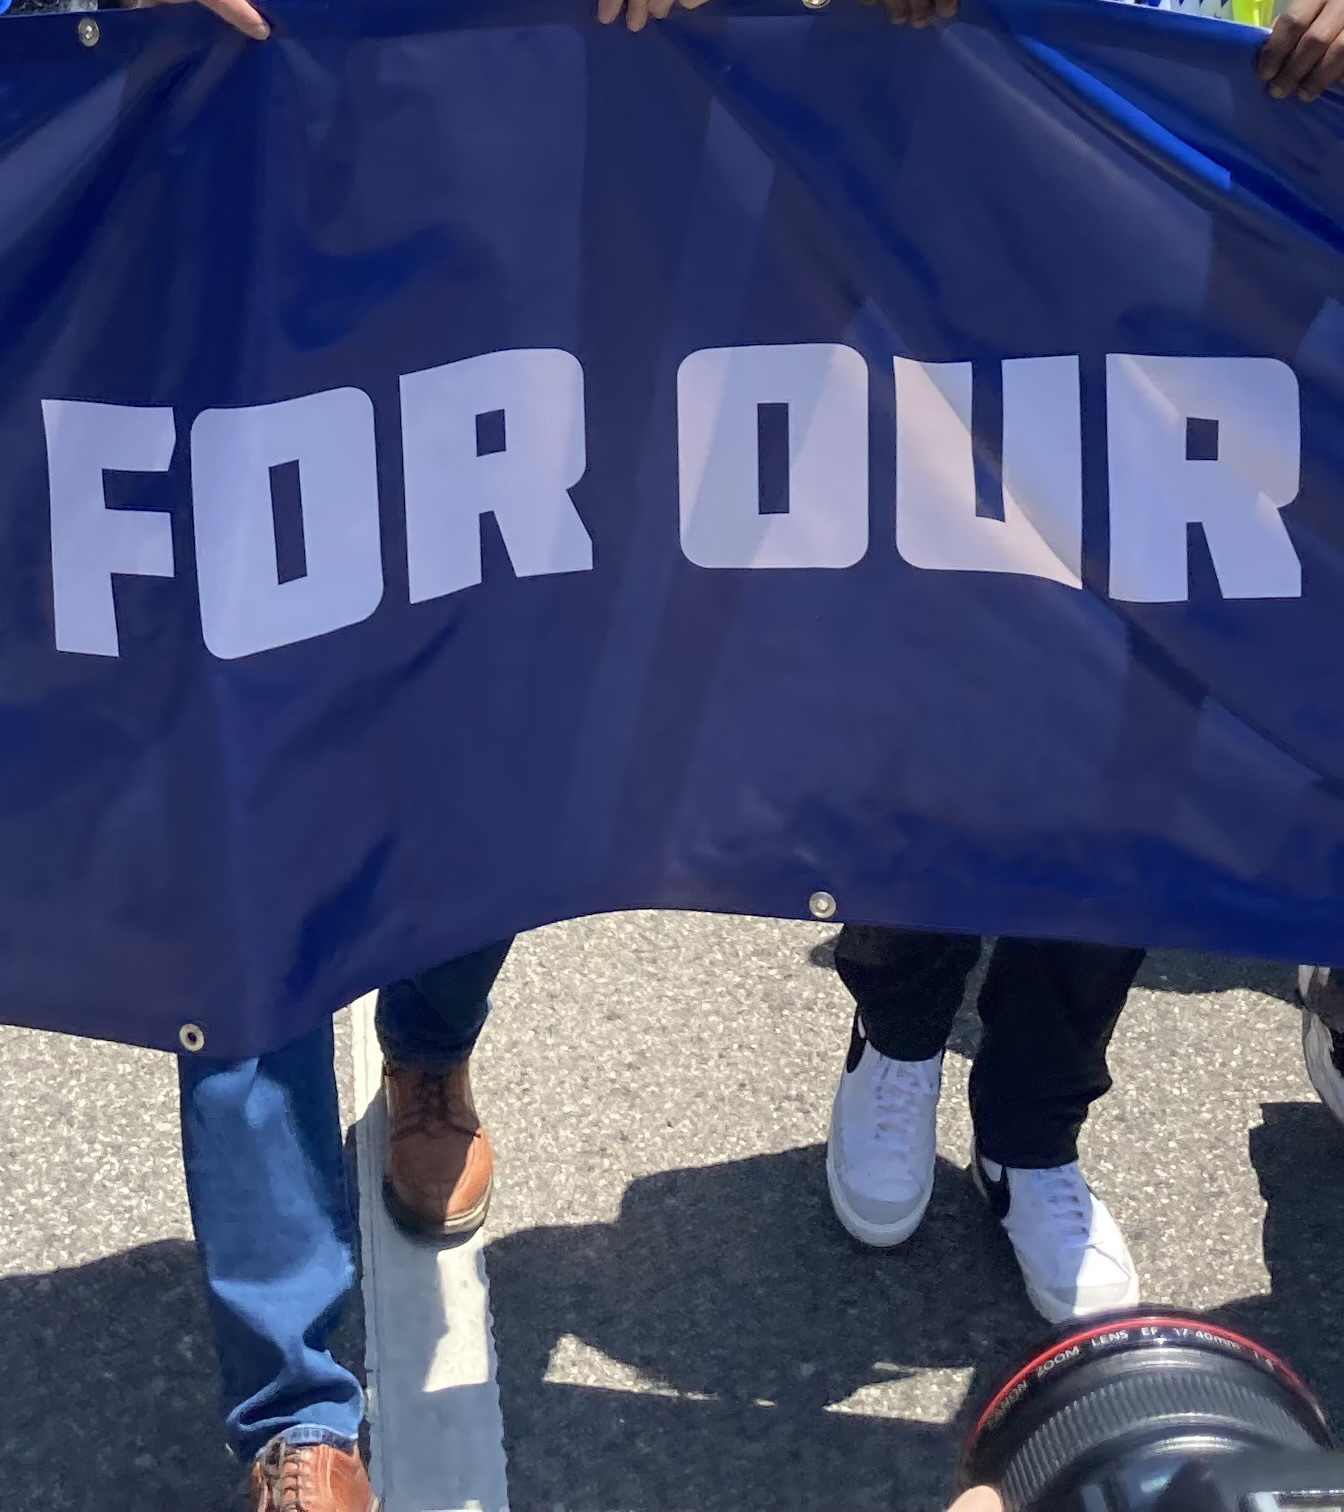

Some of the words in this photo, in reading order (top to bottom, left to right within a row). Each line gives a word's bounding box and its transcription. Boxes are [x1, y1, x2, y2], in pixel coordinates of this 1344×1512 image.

[41, 347, 594, 660] FOR
[677, 342, 1303, 604] OUR
[1037, 1345, 1081, 1379] ZOOM
[1091, 1329, 1130, 1349] LENS
[1141, 1326, 1160, 1337] EF
